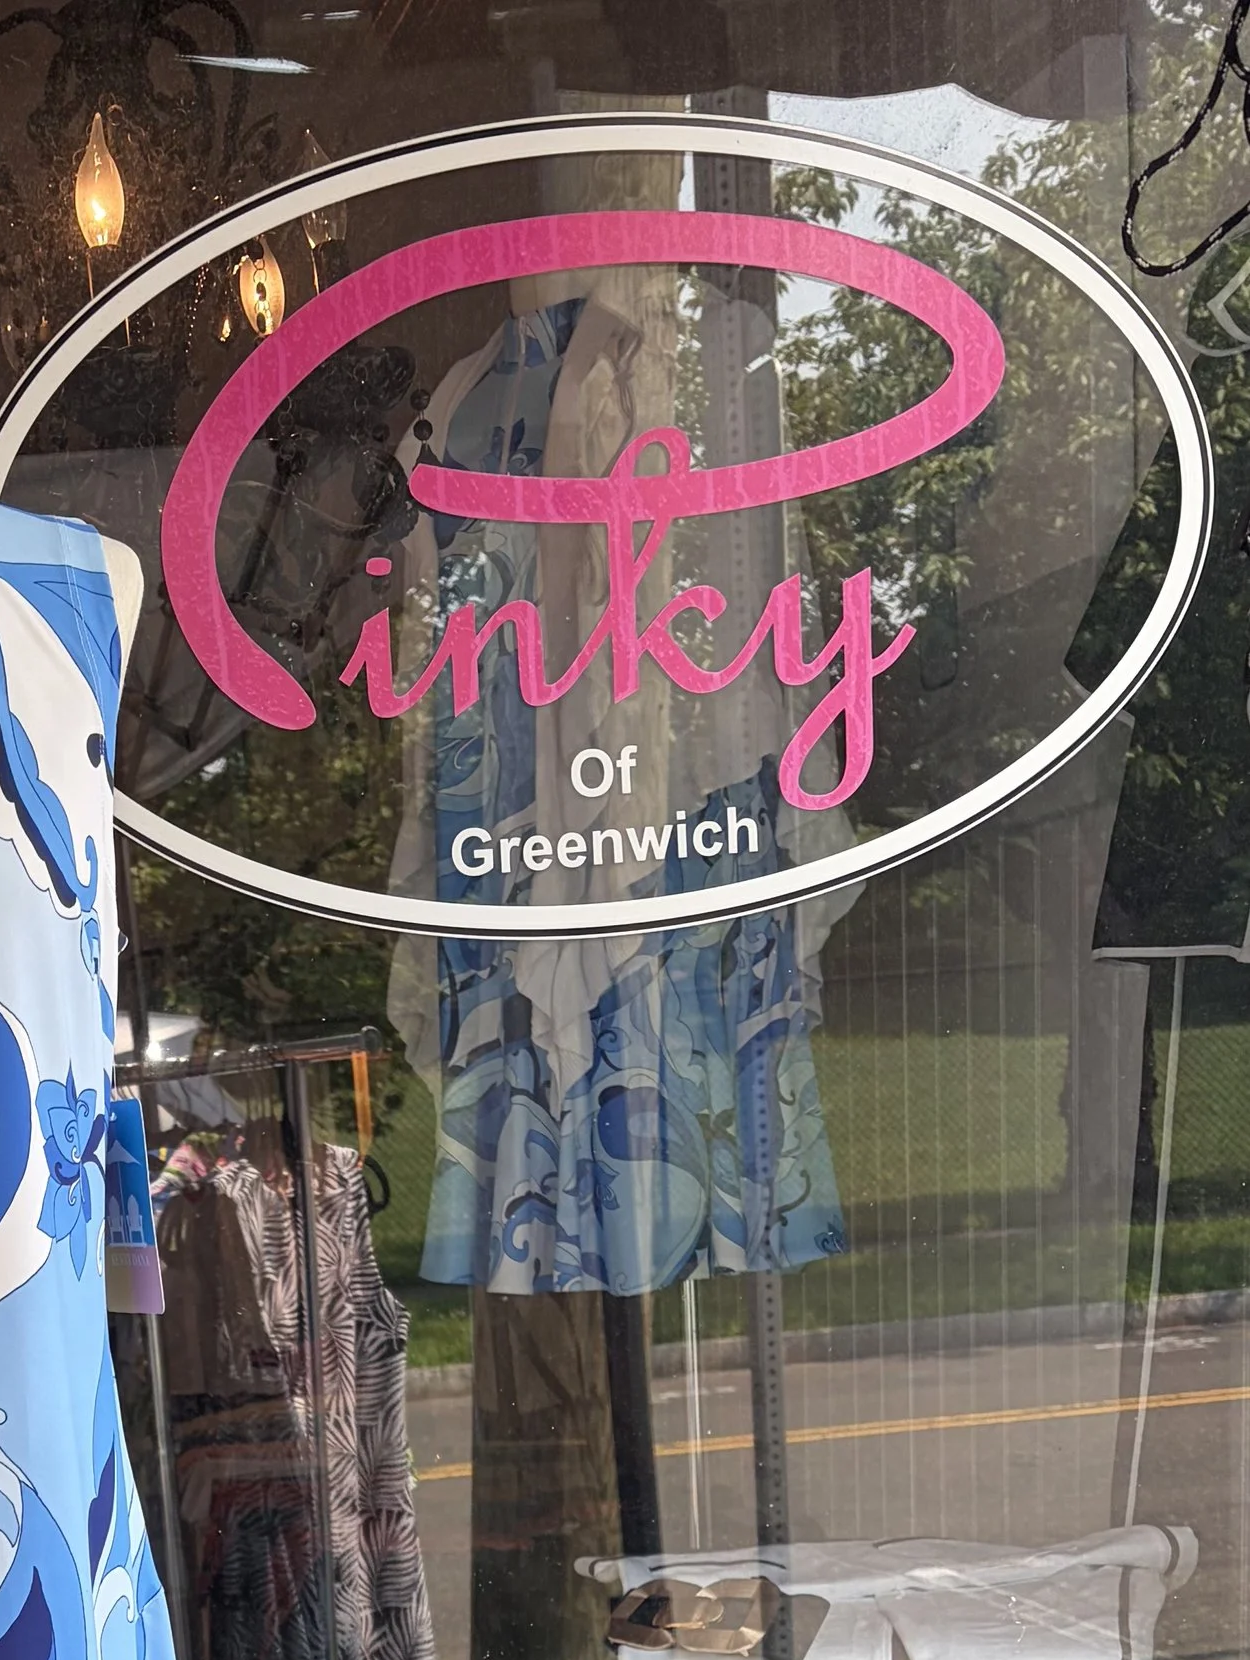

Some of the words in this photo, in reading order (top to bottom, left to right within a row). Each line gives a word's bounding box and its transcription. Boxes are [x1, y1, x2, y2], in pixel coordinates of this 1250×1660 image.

[160, 209, 1006, 810] Pinky
[570, 744, 638, 798] Of
[451, 806, 759, 877] Greenwich
